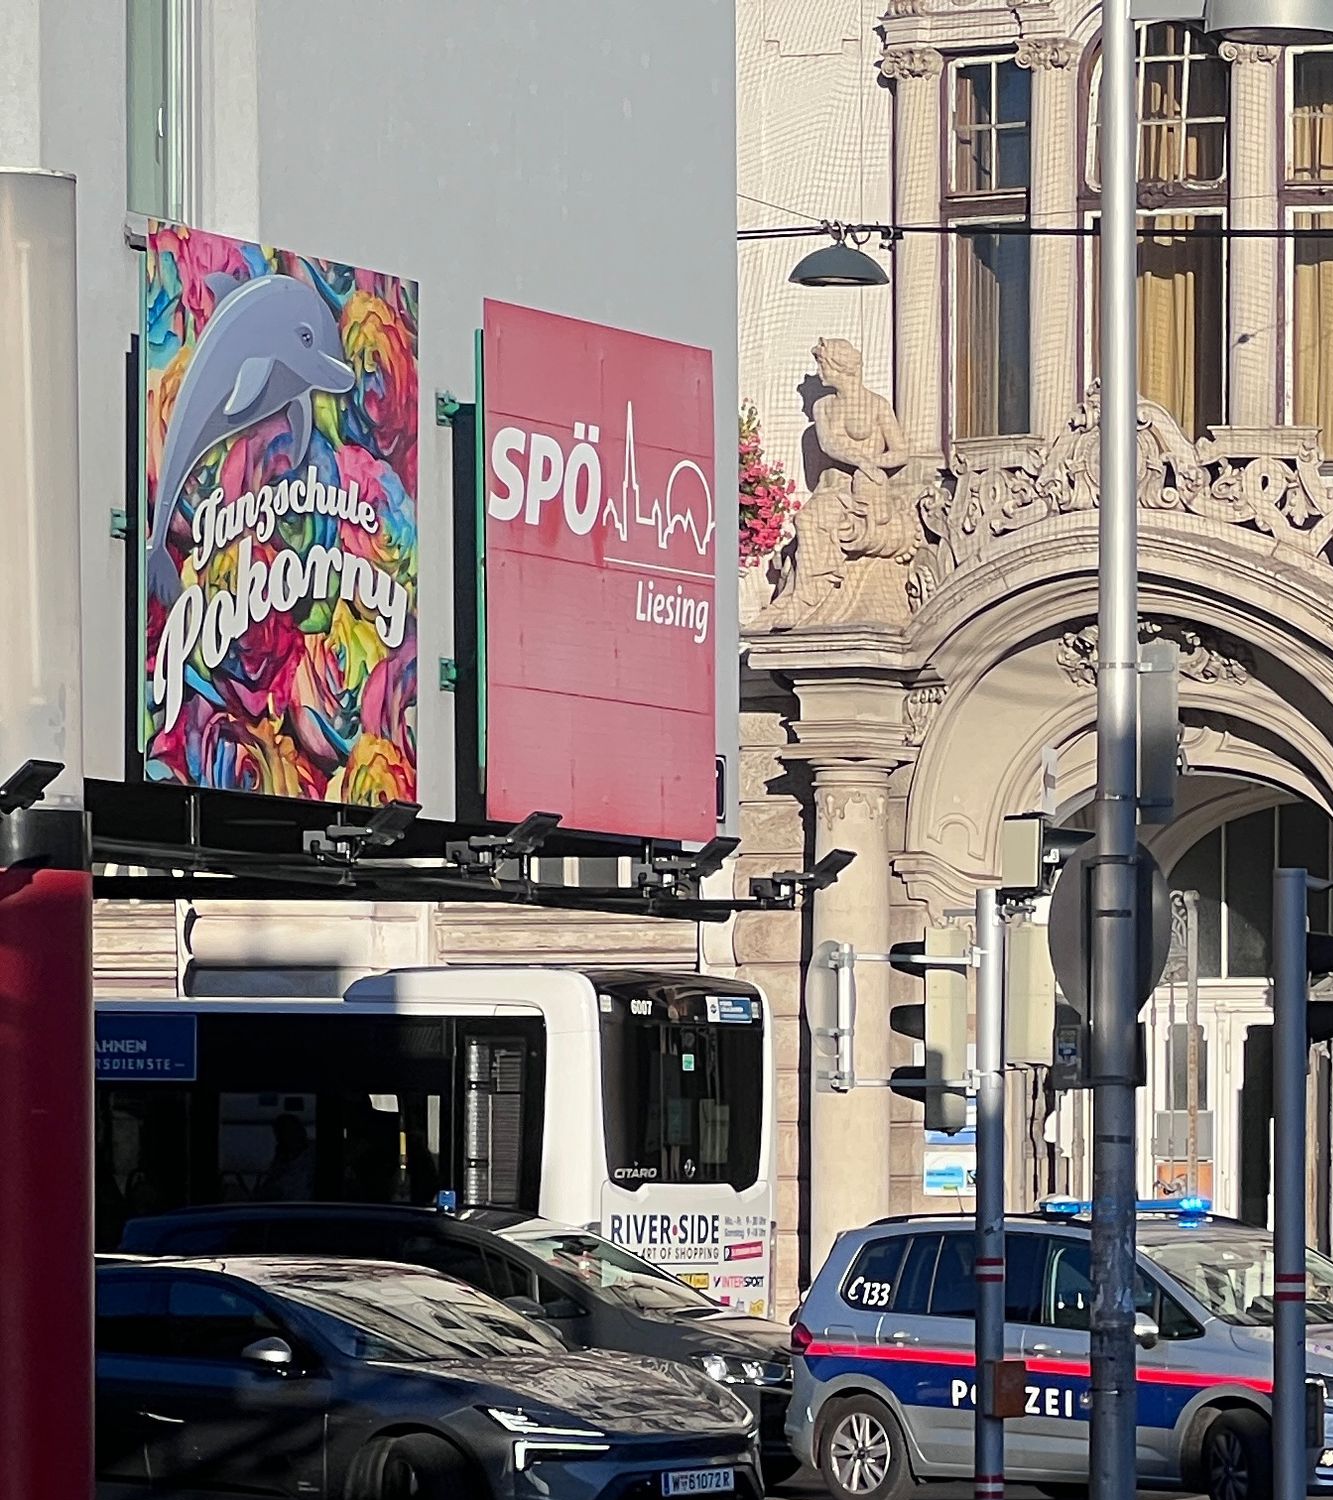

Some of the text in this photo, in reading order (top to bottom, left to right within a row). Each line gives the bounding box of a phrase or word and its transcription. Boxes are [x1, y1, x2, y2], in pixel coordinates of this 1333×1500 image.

[488, 421, 602, 535] SPÖ
[192, 465, 379, 571] Tanzschule
[635, 580, 710, 643] Liesing
[153, 535, 408, 734] Pokorny
[614, 1167, 657, 1179] CITARO
[659, 1247, 672, 1260] OF
[675, 1247, 719, 1260] SHOPPING
[722, 1275, 764, 1288] INTERSPORT
[862, 1281, 891, 1306] 133
